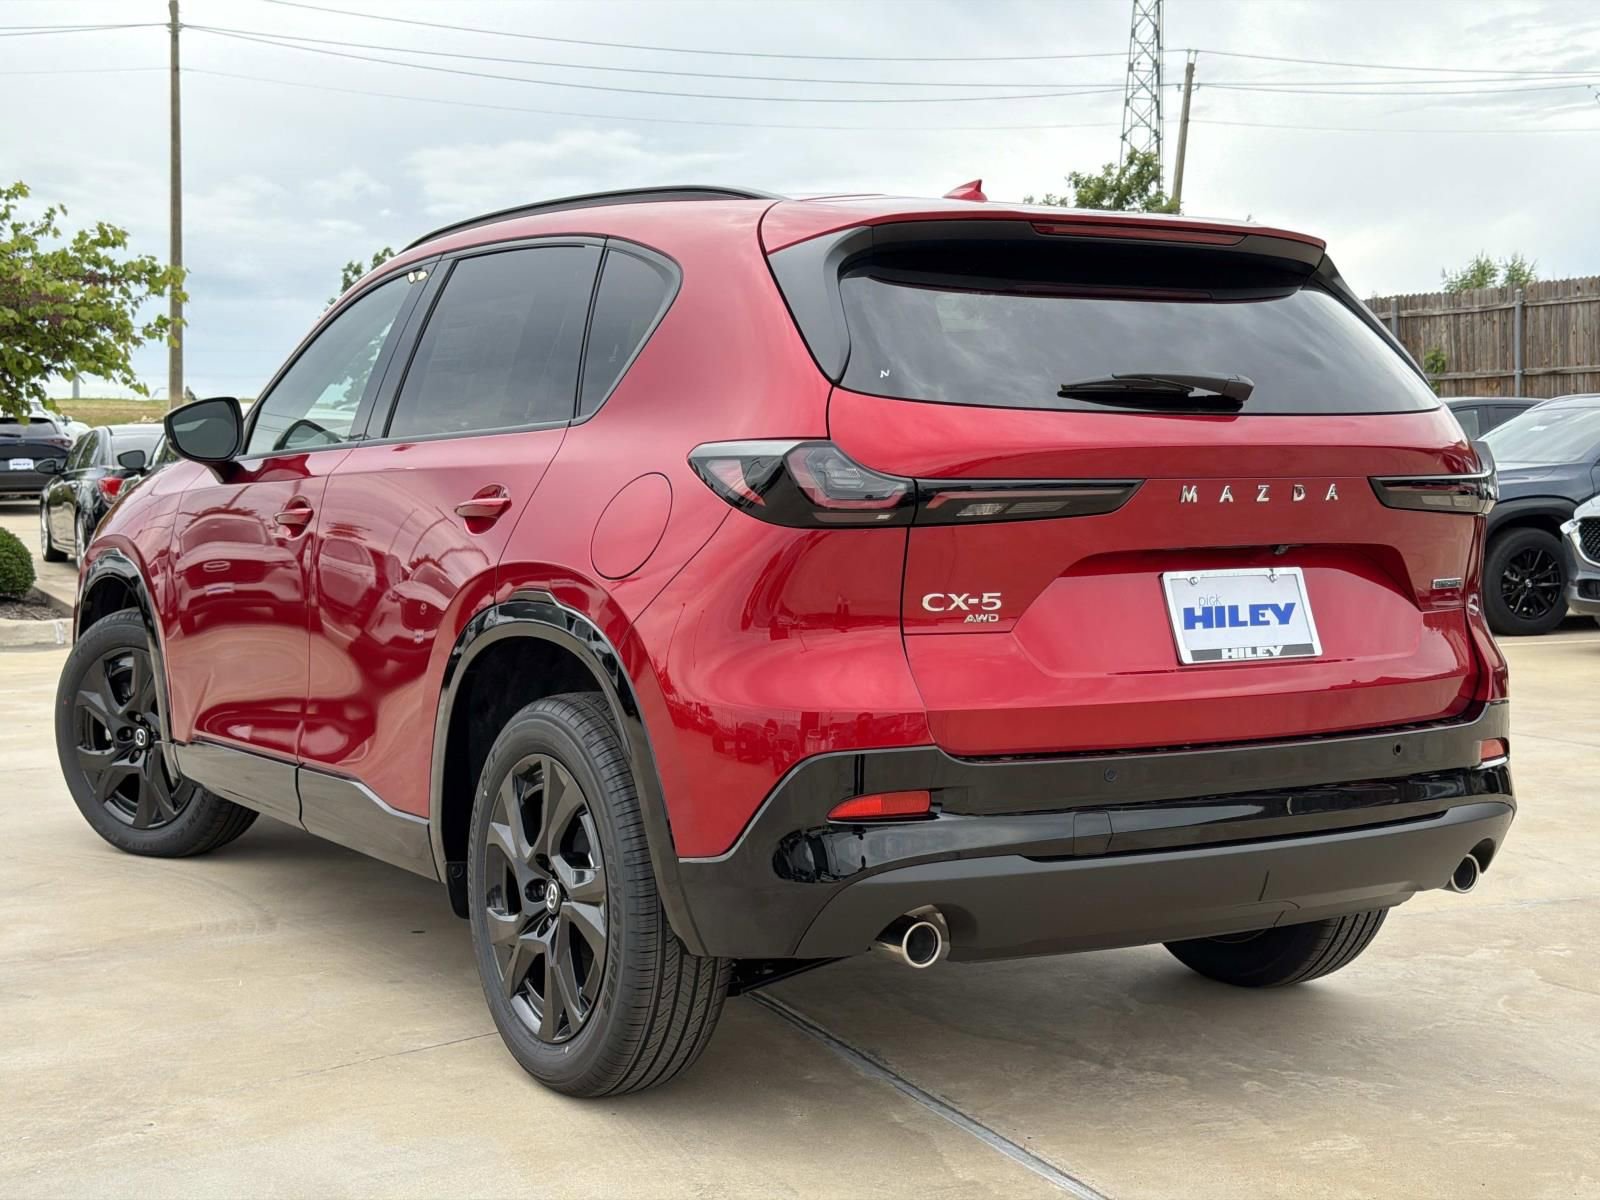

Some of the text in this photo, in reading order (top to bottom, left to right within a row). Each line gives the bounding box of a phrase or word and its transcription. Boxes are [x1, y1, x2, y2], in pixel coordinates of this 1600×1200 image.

[1181, 484, 1338, 503] MAZDA
[922, 592, 1002, 611] CX-5
[1198, 594, 1223, 608] pick
[964, 613, 999, 623] AWD
[1183, 603, 1296, 630] HILEY
[1221, 645, 1284, 659] HILEY
